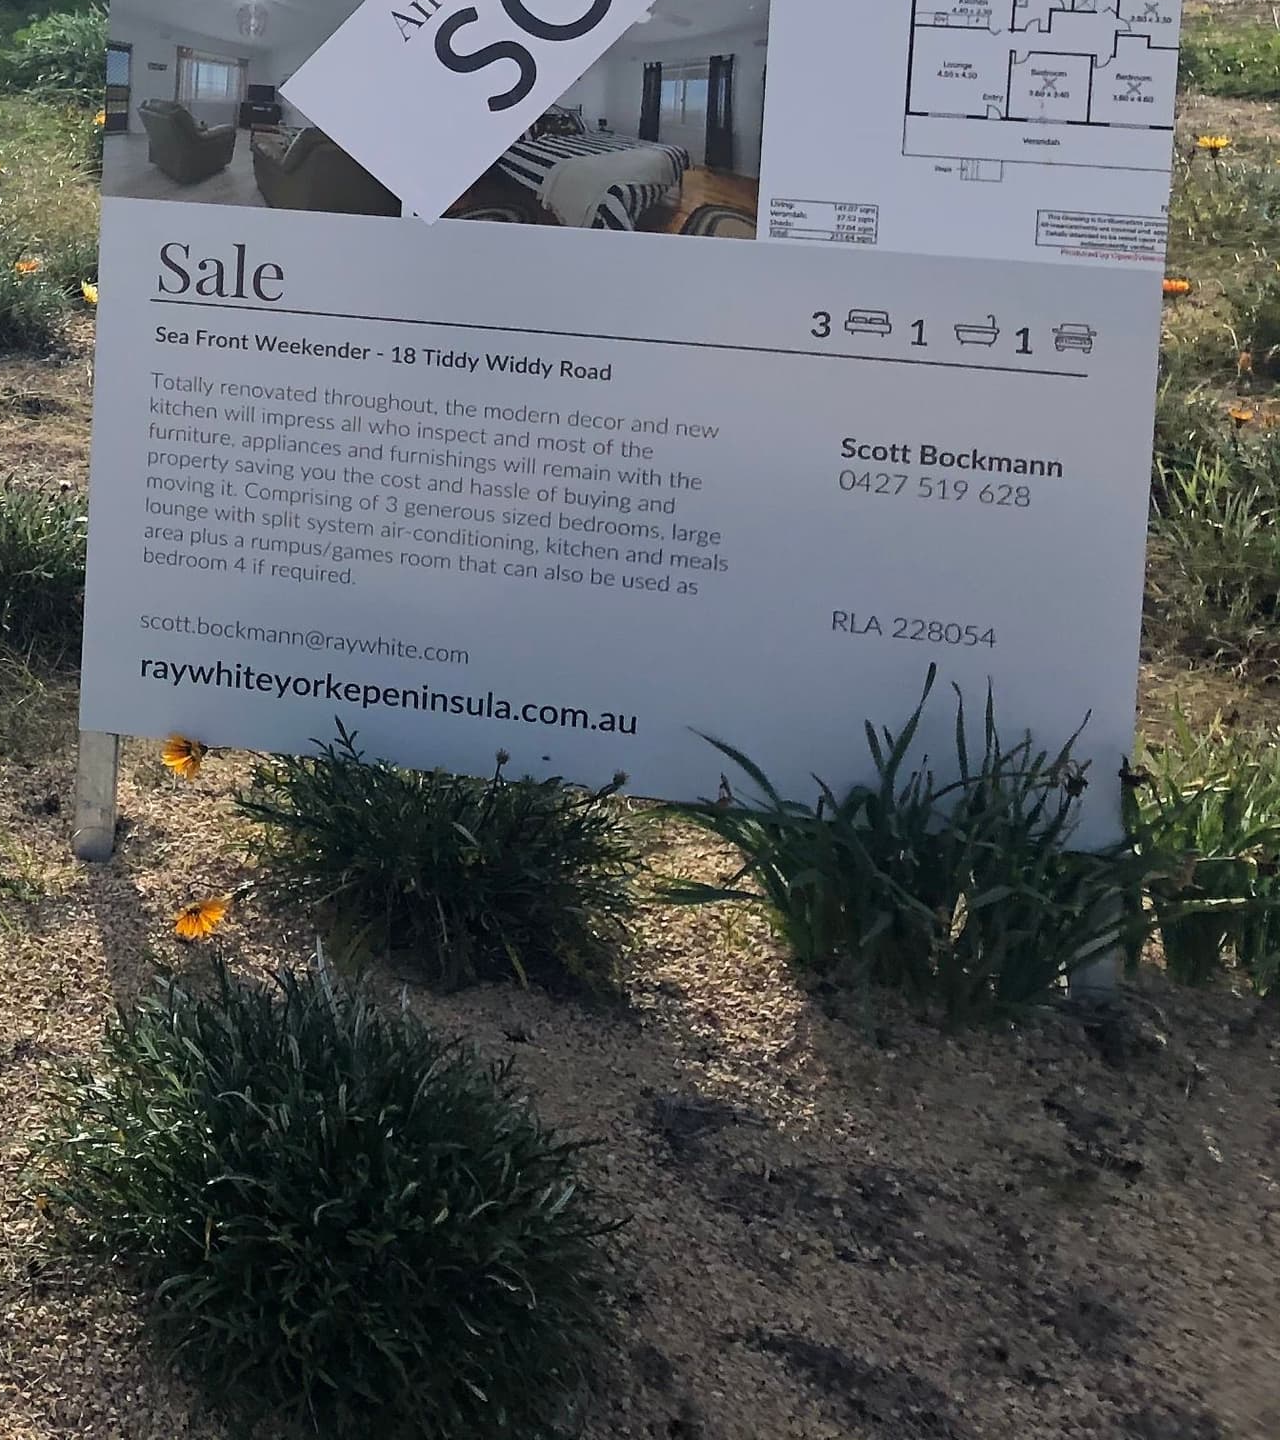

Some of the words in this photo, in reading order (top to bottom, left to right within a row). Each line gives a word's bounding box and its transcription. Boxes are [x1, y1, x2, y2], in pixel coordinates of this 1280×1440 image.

[943, 61, 972, 70] Lounge
[982, 93, 1004, 102] Entry
[157, 241, 285, 302] Sale
[154, 325, 189, 345] Sea
[196, 329, 249, 350] Front
[254, 333, 371, 360] Weekender
[391, 345, 416, 365] 18
[421, 348, 480, 373] Tiddy
[485, 353, 554, 380] Widdy
[559, 360, 612, 381] Road
[810, 311, 832, 338] 3
[911, 319, 928, 346] 1
[1015, 327, 1033, 354] 1
[150, 371, 214, 397] Totally
[220, 382, 317, 403] renovated
[324, 387, 438, 416] throughout,
[446, 398, 477, 418] the
[484, 404, 560, 425] modern
[567, 409, 626, 431] decor
[631, 416, 669, 435] and
[675, 423, 719, 439] new
[150, 395, 217, 419] kitchen
[224, 404, 255, 423] will
[262, 407, 335, 431] impress
[340, 415, 361, 433] all
[367, 418, 410, 437] who
[417, 421, 488, 445] inspect
[493, 431, 530, 448] and
[537, 436, 587, 454] most
[592, 438, 614, 456] of
[621, 440, 654, 460] the
[147, 451, 229, 474] property
[234, 458, 294, 481] saving
[300, 465, 336, 482] you
[343, 466, 374, 485] the
[380, 473, 422, 490] cost
[427, 476, 463, 494] and
[470, 477, 530, 500] hassle
[536, 485, 558, 503] of
[564, 486, 632, 514] buying
[637, 496, 676, 514] and
[149, 421, 235, 448] furniture,
[241, 433, 342, 457] appliances
[347, 443, 383, 461] and
[389, 444, 497, 474] furnishings
[503, 456, 536, 475] will
[543, 463, 611, 482] remain
[617, 467, 662, 488] with
[669, 471, 702, 491] the
[840, 437, 911, 464] Scott
[920, 444, 1064, 478] Bockmann
[146, 475, 215, 498] moving
[221, 478, 237, 497] it.
[244, 481, 353, 512] Comprising
[358, 494, 380, 511] of
[385, 495, 398, 513] 3
[404, 501, 495, 523] generous
[502, 507, 552, 528] sized
[558, 511, 664, 541] bedrooms,
[672, 522, 721, 548] large
[839, 469, 909, 496] 0427
[919, 478, 969, 502] 519
[979, 484, 1032, 508] 628
[144, 525, 183, 542] area
[190, 527, 228, 547] plus
[234, 535, 244, 548] a
[251, 535, 393, 564] rumpus/games
[400, 552, 451, 569] room
[459, 554, 497, 575] that
[503, 563, 537, 579] can
[543, 563, 584, 583] also
[590, 567, 615, 587] be
[622, 574, 670, 592] used
[676, 580, 698, 595] as
[145, 496, 209, 522] lounge
[214, 505, 255, 524] with
[261, 509, 301, 530] split
[307, 516, 374, 536] system
[380, 521, 539, 556] air-conditioning,
[546, 535, 619, 561] kitchen
[625, 547, 663, 566] and
[669, 553, 728, 572] meals
[143, 545, 227, 572] bedroom
[233, 556, 247, 573] 4
[252, 557, 265, 575] if
[271, 564, 356, 585] required.
[140, 614, 469, 665] scott.bockmann@raywhite.com
[832, 610, 883, 636] RLA
[892, 617, 998, 649] 228054
[141, 659, 637, 734] raywhiteyorkepeninsula.com.au
